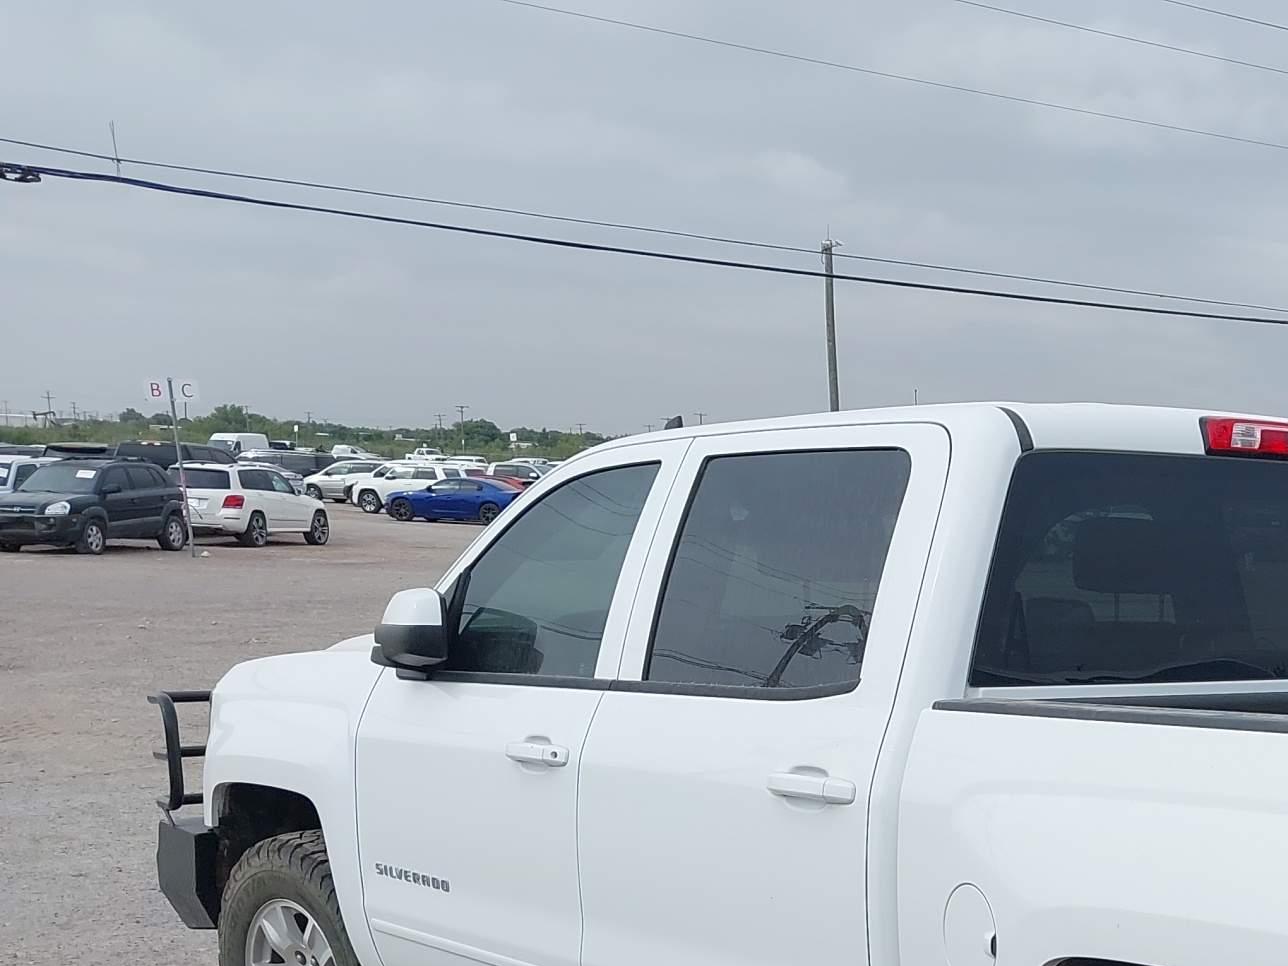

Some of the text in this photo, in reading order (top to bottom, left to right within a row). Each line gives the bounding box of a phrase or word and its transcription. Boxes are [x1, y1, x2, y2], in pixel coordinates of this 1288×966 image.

[150, 382, 162, 397] B
[181, 383, 194, 398] C
[375, 862, 451, 893] SILVERADO
